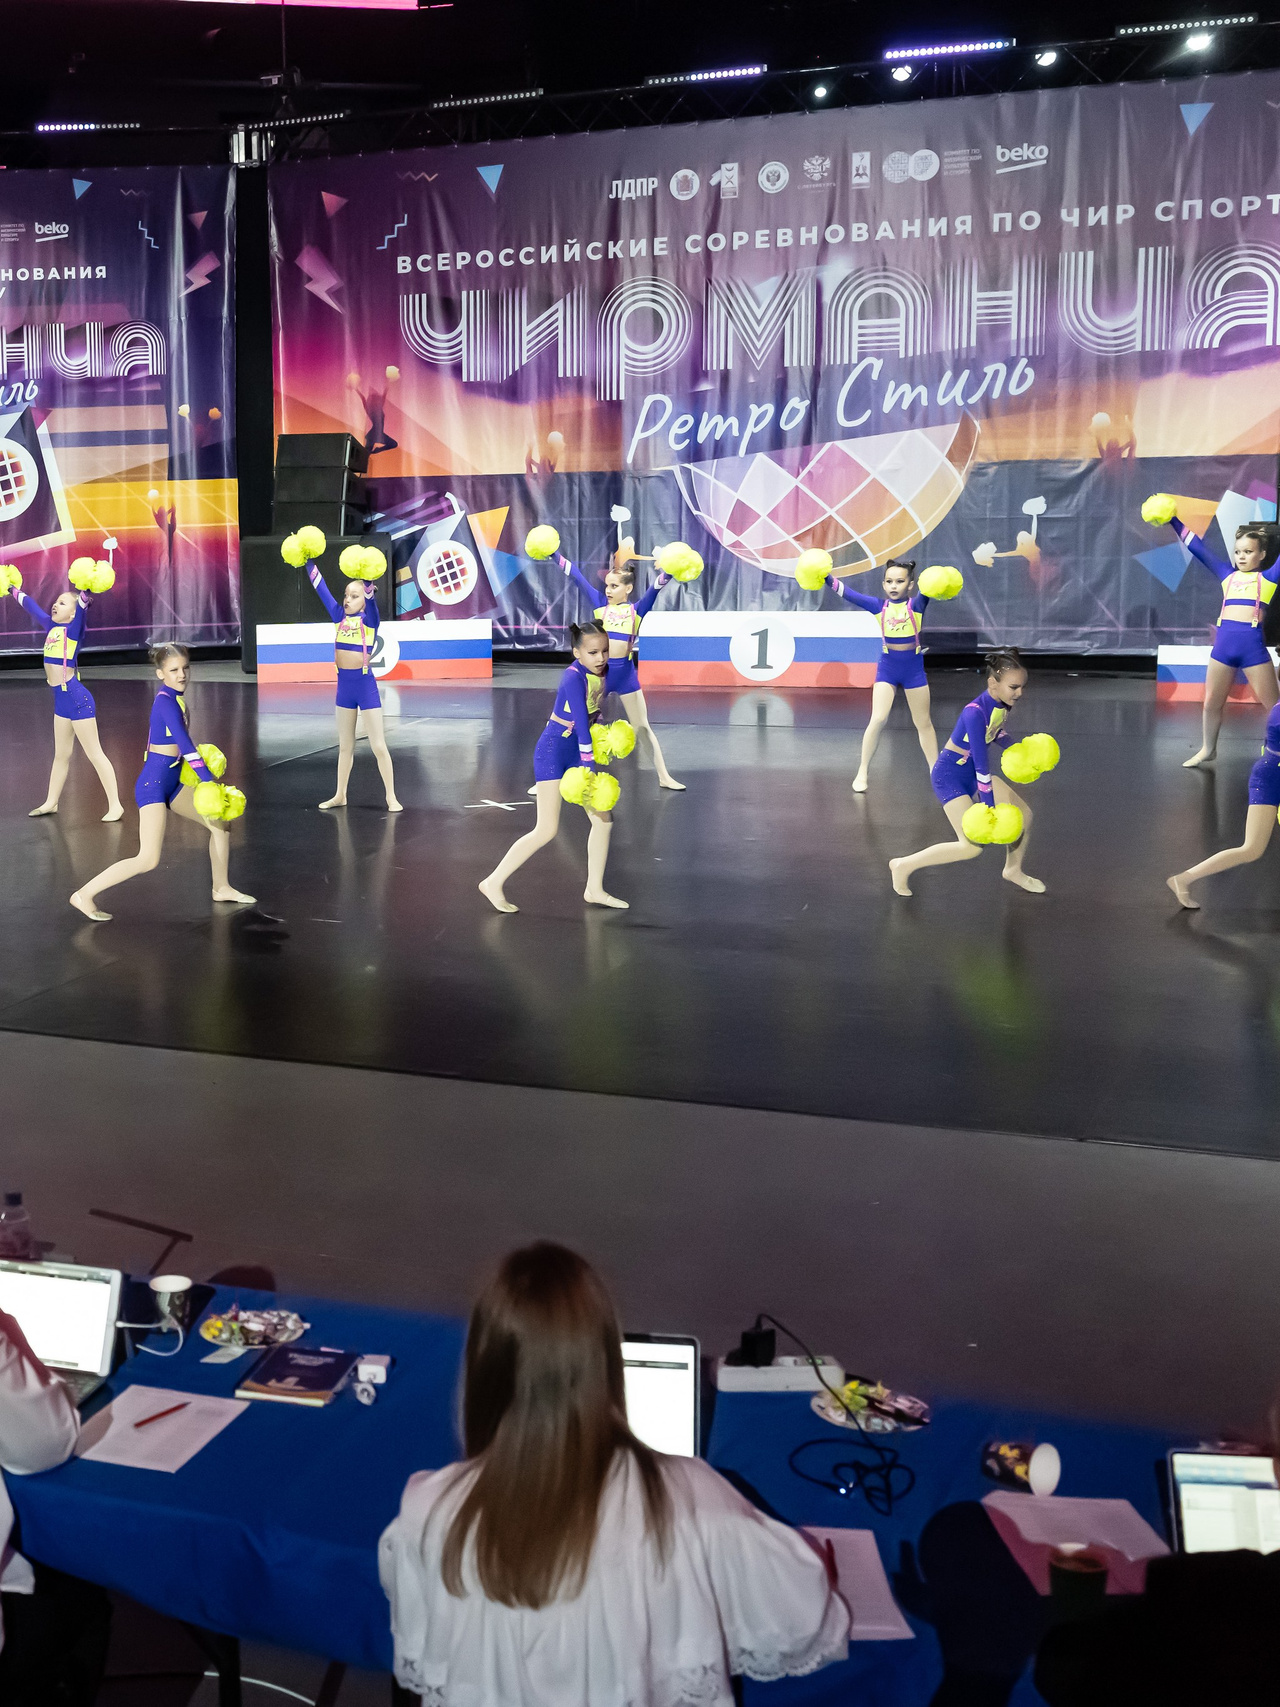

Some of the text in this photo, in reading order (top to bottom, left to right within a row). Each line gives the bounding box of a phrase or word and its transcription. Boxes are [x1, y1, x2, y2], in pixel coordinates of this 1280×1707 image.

[996, 143, 1049, 162] beko
[609, 177, 659, 200] ЛДПР
[35, 222, 70, 235] beko
[396, 237, 669, 274] ВСЕРОССИЙСКИЕ
[684, 214, 973, 255] СОРЕВНОВАНИЯ
[992, 210, 1042, 233] ПО
[1060, 204, 1136, 228] ЧИР
[625, 356, 1036, 465] Ретро Стиль
[369, 635, 386, 668] 2
[751, 628, 774, 669] 1
